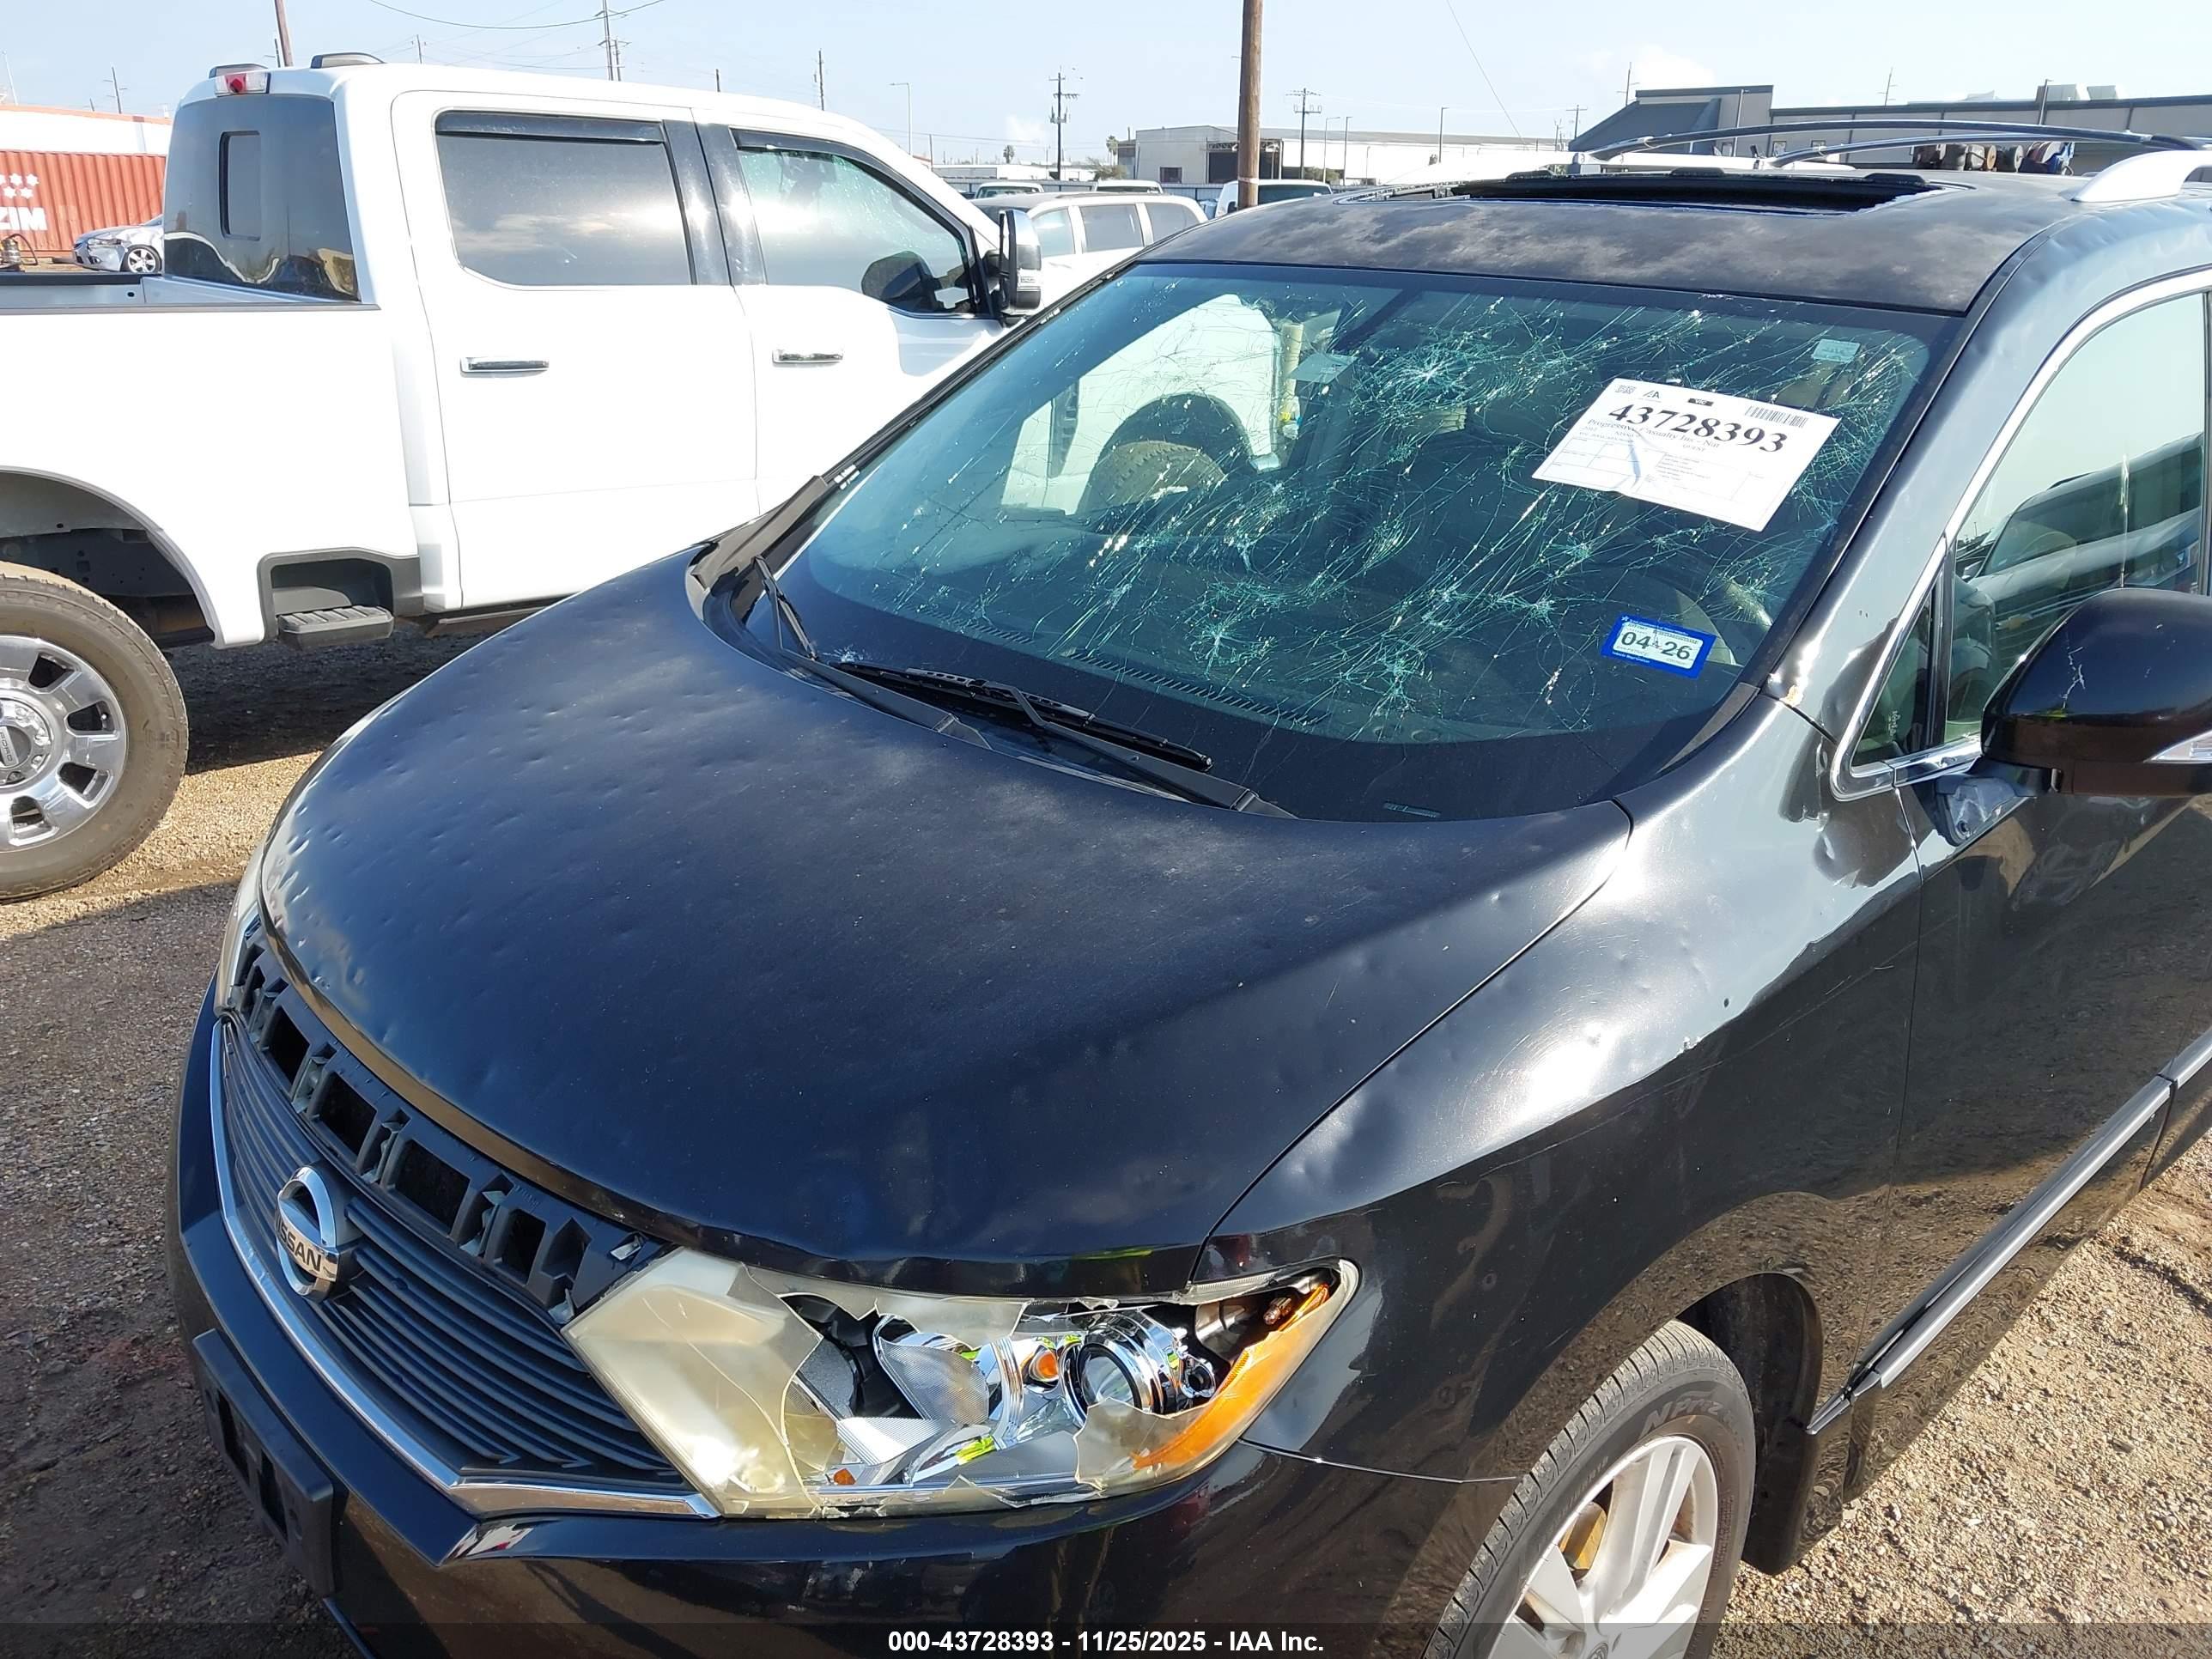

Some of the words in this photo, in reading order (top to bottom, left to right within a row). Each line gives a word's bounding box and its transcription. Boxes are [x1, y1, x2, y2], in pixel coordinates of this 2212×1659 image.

[1608, 404, 1788, 453] 43728393
[1621, 631, 1651, 649] 04
[1661, 641, 1693, 659] 26
[0, 732, 13, 762] FORD
